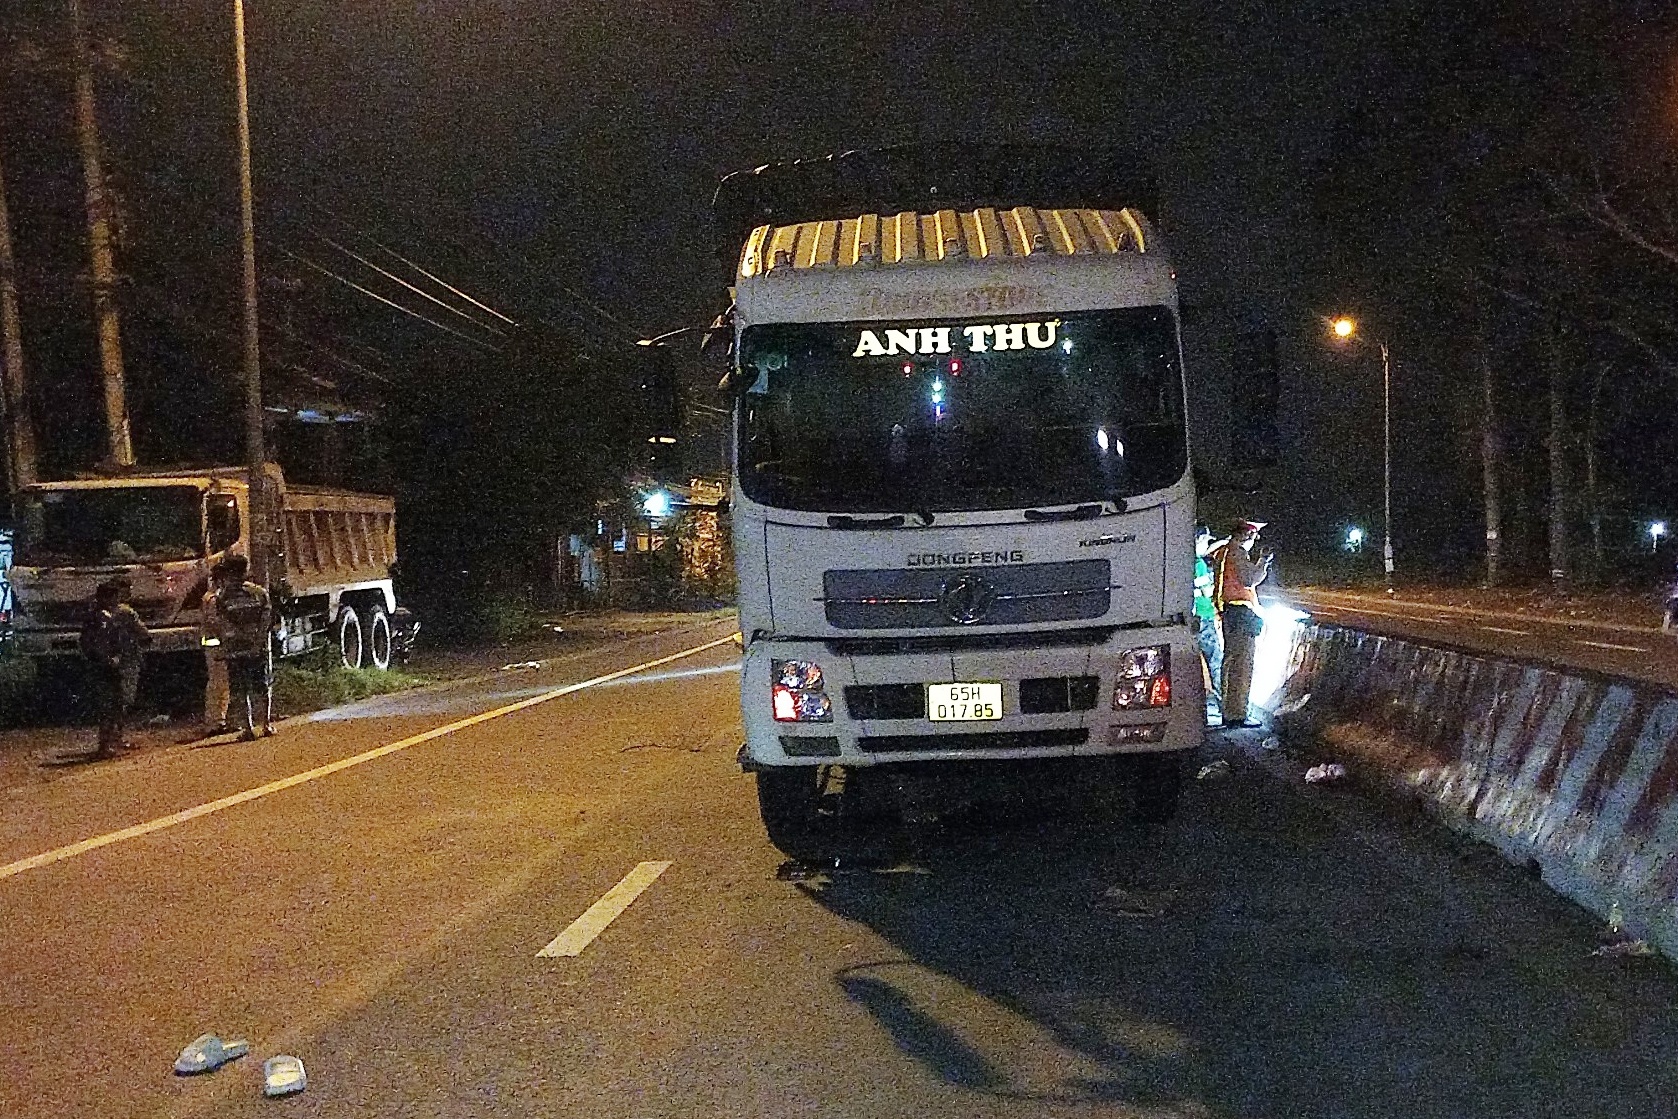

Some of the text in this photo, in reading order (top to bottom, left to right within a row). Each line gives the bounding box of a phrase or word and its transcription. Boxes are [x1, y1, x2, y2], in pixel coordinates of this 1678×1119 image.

[852, 327, 952, 357] ANH
[907, 550, 1024, 566] DONGFENG
[950, 686, 981, 701] 65H
[937, 703, 994, 719] 017.85
